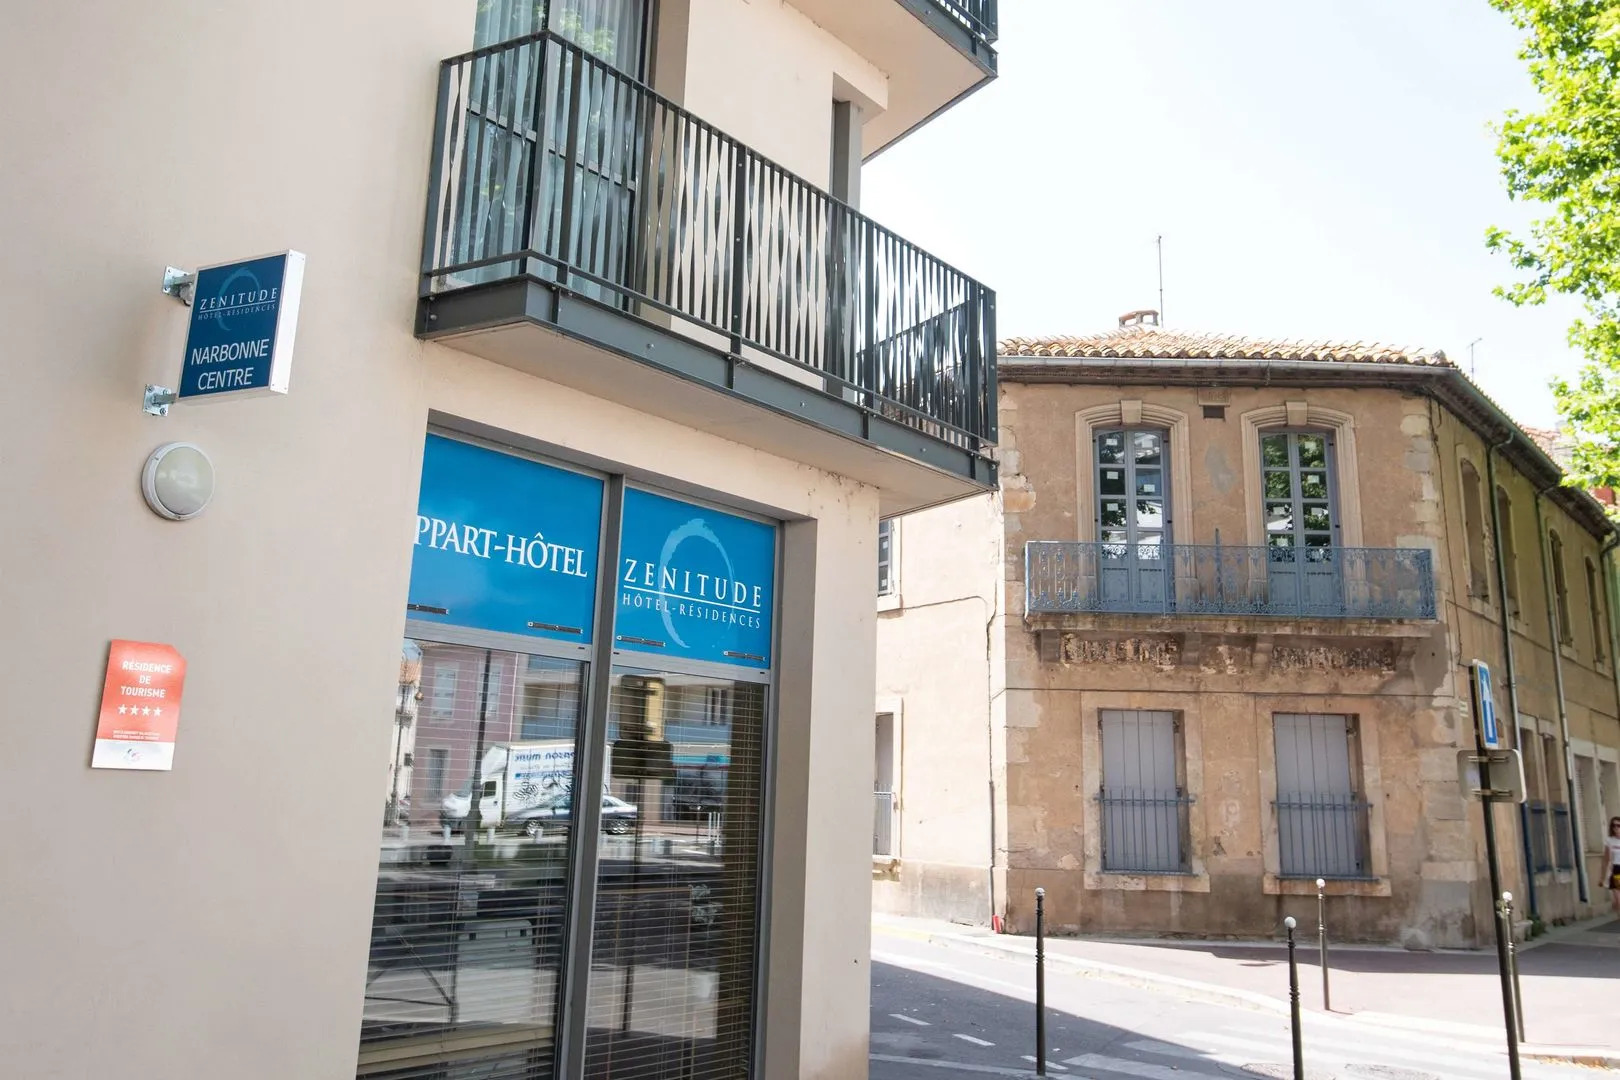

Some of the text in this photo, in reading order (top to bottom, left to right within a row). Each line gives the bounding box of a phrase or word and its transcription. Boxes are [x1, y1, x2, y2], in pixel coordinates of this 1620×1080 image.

[200, 287, 278, 310] ZENITUDE
[191, 338, 270, 366] NARBONNE
[197, 367, 254, 391] CENTRE
[624, 558, 762, 607] ZENITUDE
[622, 592, 761, 629] HÔTEL-RÉSIDENCES
[139, 674, 151, 685] DE
[120, 685, 166, 699] TOURISME
